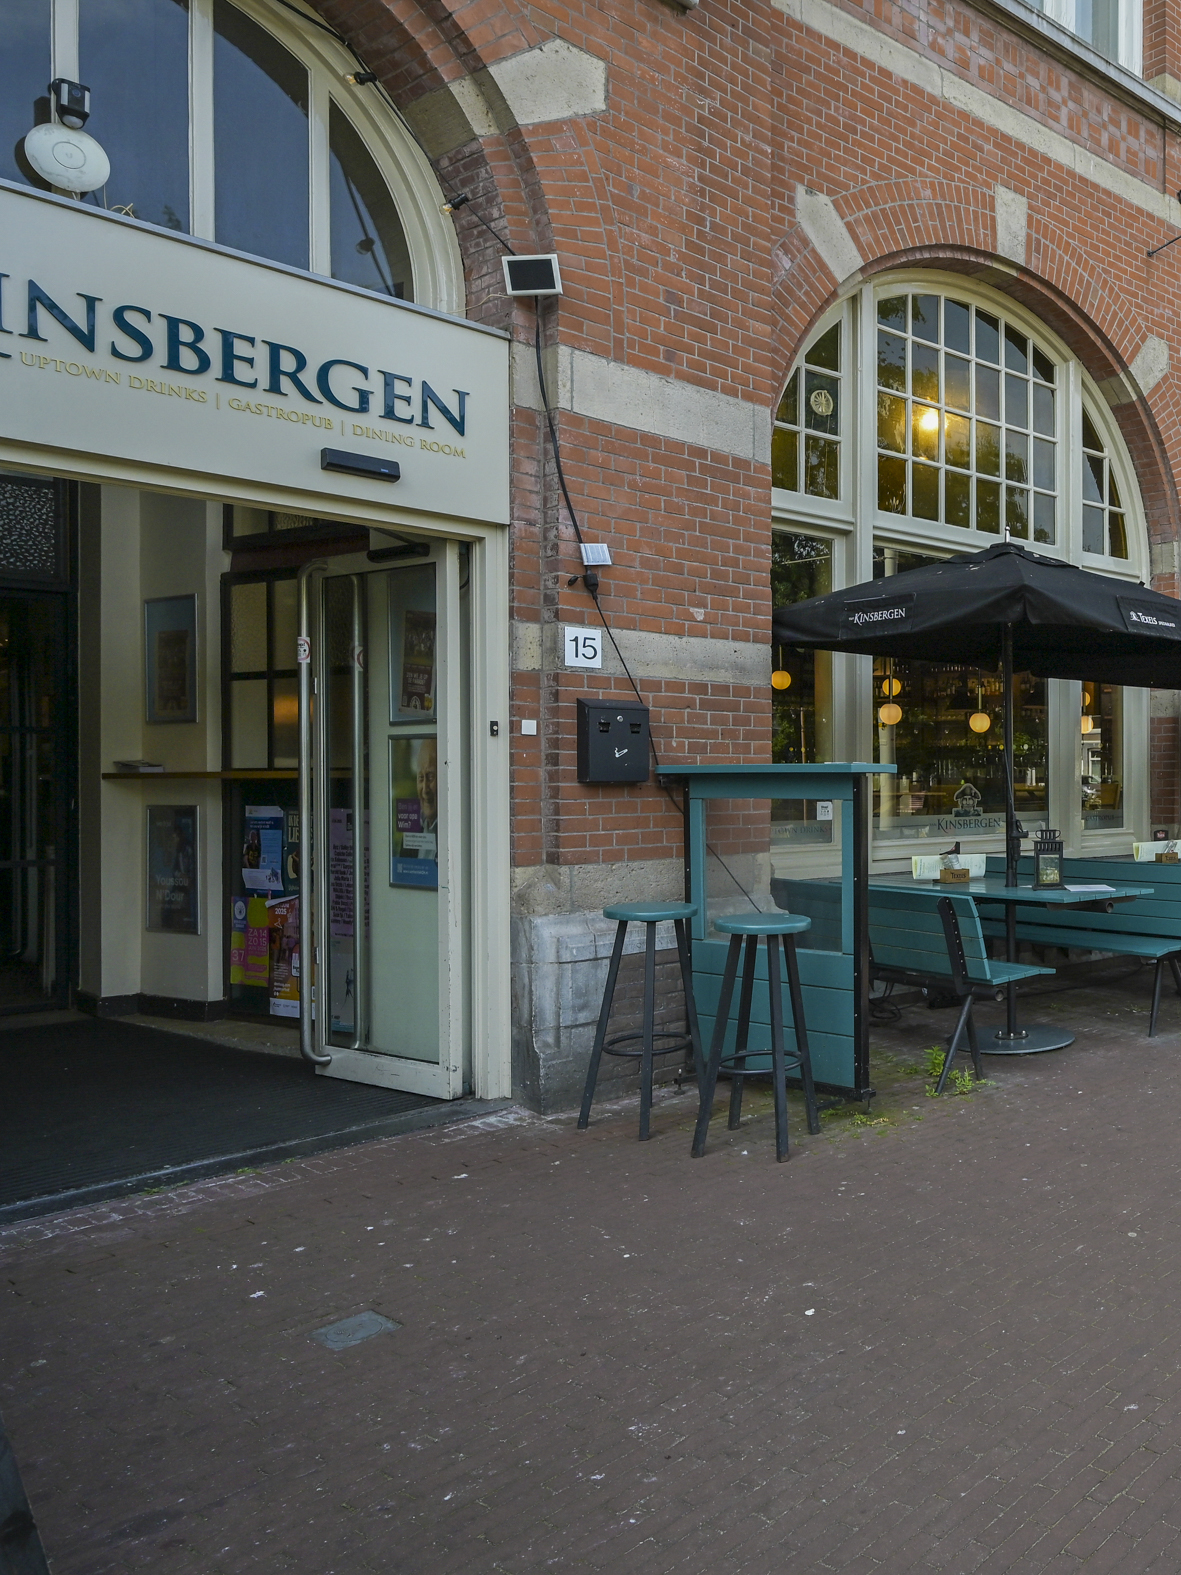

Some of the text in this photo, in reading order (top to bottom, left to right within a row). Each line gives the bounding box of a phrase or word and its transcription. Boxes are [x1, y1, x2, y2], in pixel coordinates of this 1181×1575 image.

[20, 351, 467, 459] UPTOWN DRINKS GASTROPUB DINING ROOM
[854, 608, 906, 626] KINSBERGEN
[568, 635, 598, 661] 15
[409, 813, 418, 821] opa
[397, 820, 412, 829] Wim?
[799, 825, 828, 834] DRINKS
[936, 817, 1001, 833] KINSBERGEN
[155, 875, 189, 887] Youssou
[248, 928, 267, 938] ZA 14
[248, 937, 267, 946] ZO 15
[232, 950, 245, 962] 37
